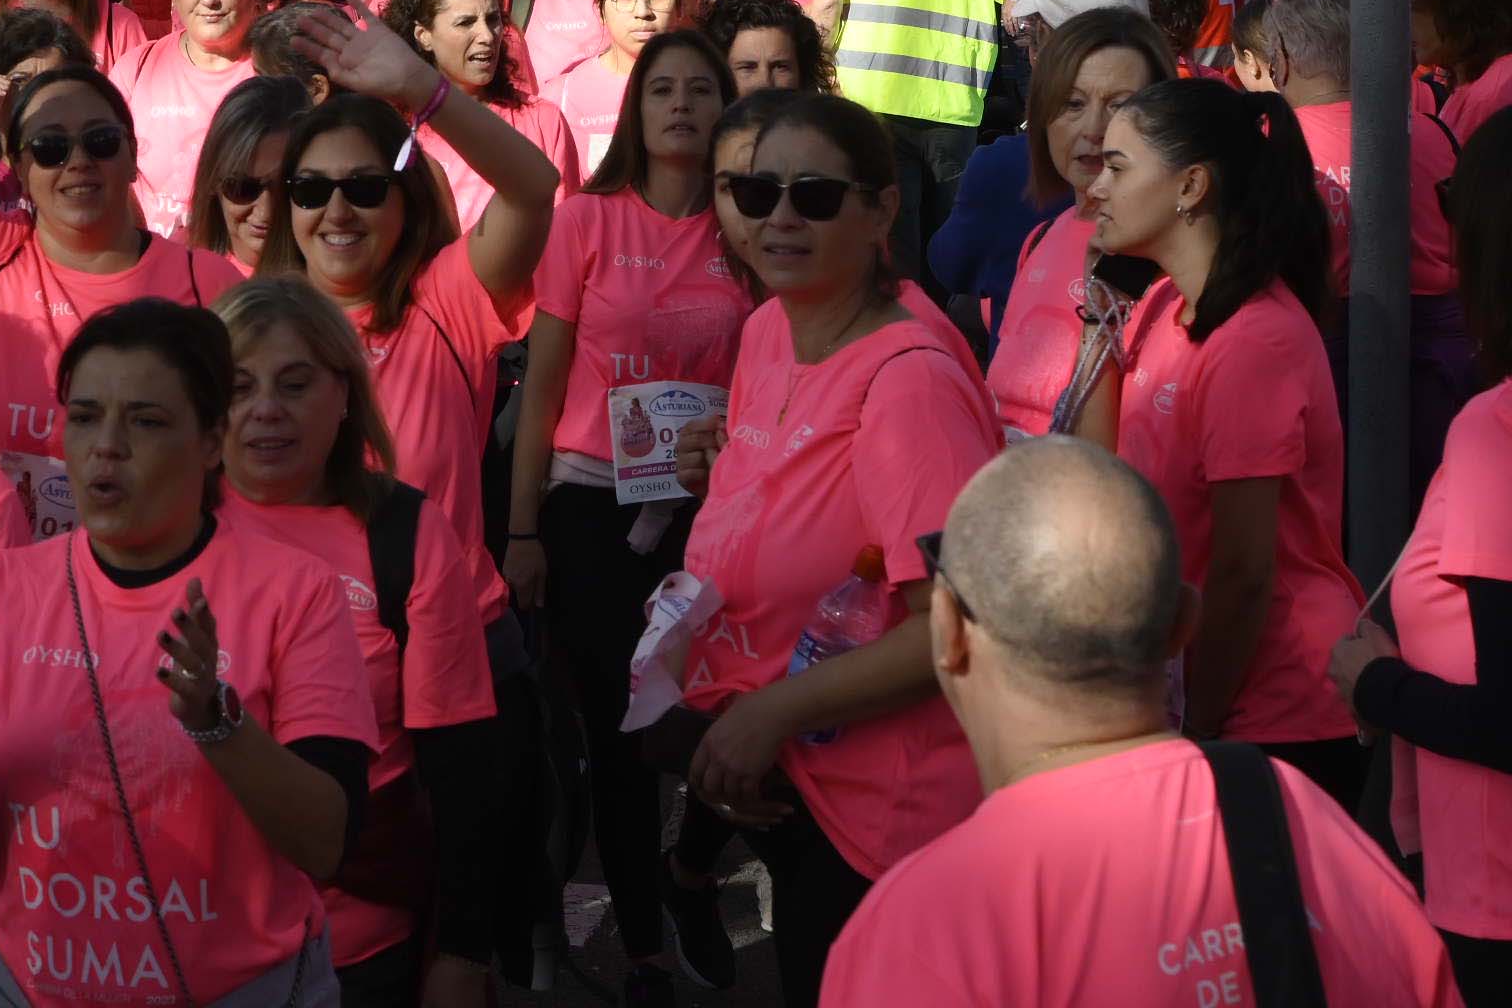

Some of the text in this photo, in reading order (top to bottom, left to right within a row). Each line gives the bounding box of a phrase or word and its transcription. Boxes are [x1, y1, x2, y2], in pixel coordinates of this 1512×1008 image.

[580, 114, 620, 126] OYSH
[614, 253, 665, 271] OYSHO
[610, 352, 650, 380] TU
[652, 397, 705, 412] ASTURIANA
[8, 402, 56, 440] TU
[631, 463, 670, 476] CARRERA
[629, 480, 672, 494] OYSHO
[41, 516, 75, 537] 01
[23, 644, 100, 670] OYSHO
[8, 802, 61, 850] TU
[18, 866, 219, 923] DORSAL
[26, 929, 169, 989] SUMA
[1157, 921, 1247, 976] CARR
[1196, 970, 1242, 1008] DE
